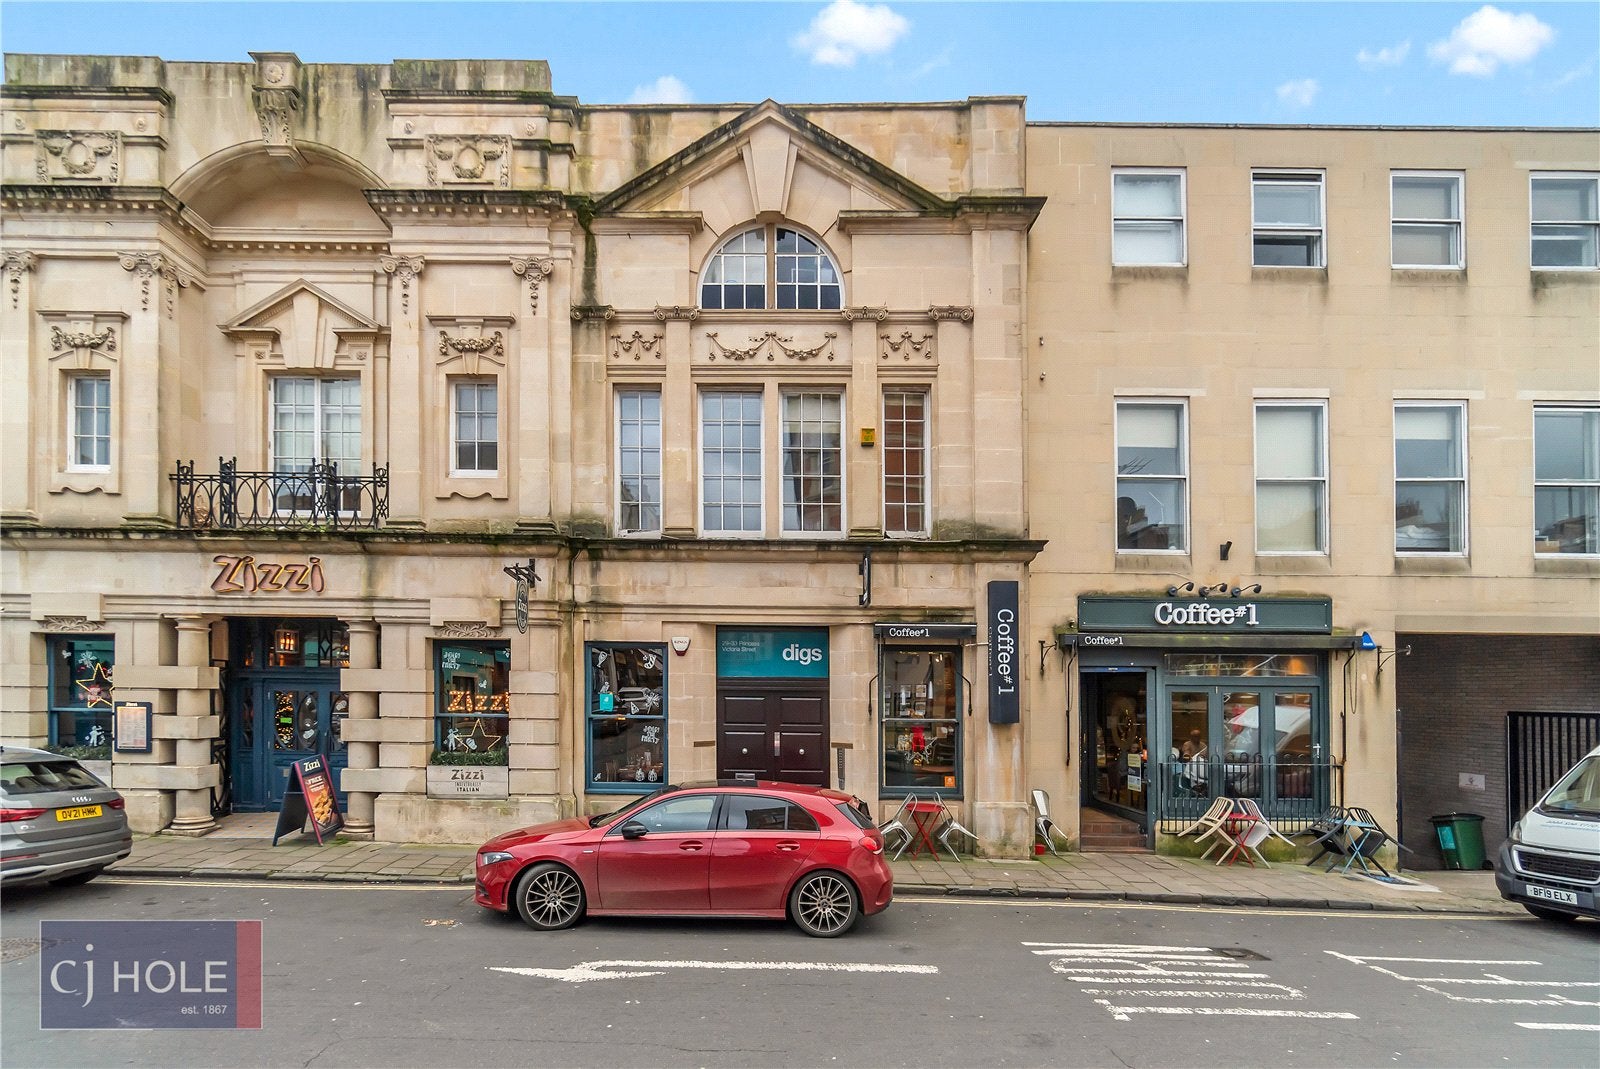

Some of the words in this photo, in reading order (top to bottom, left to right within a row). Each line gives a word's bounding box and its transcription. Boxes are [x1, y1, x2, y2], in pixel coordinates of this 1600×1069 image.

[210, 555, 324, 593] Zizzi
[1155, 602, 1259, 625] Coffee#1
[889, 627, 930, 637] Coffee#1
[1084, 636, 1124, 645] Coffee#1
[782, 643, 823, 666] digs
[997, 608, 1015, 695] Coffee#1
[303, 759, 321, 772] Zizzi
[451, 769, 485, 780] Zizzi
[1533, 887, 1552, 899] BF19
[1554, 890, 1572, 902] ELX
